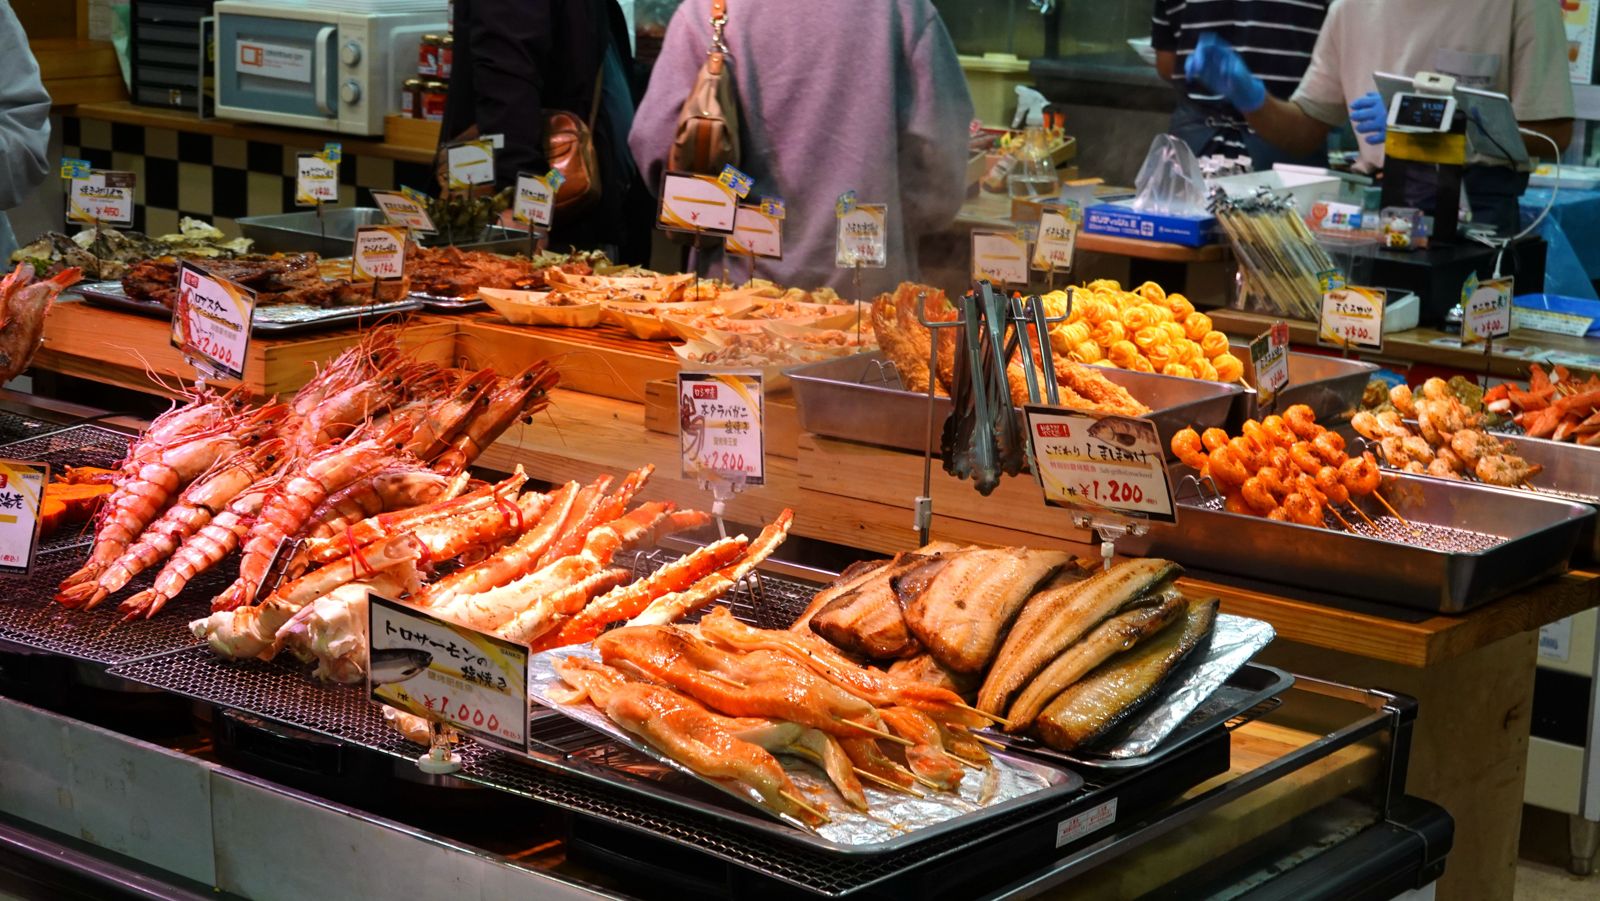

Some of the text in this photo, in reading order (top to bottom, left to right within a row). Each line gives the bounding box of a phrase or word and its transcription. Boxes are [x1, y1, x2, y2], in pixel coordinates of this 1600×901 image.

[1045, 445, 1080, 457] こだわり
[386, 620, 488, 667] トロサーモンの
[461, 666, 507, 691] 塩焼き
